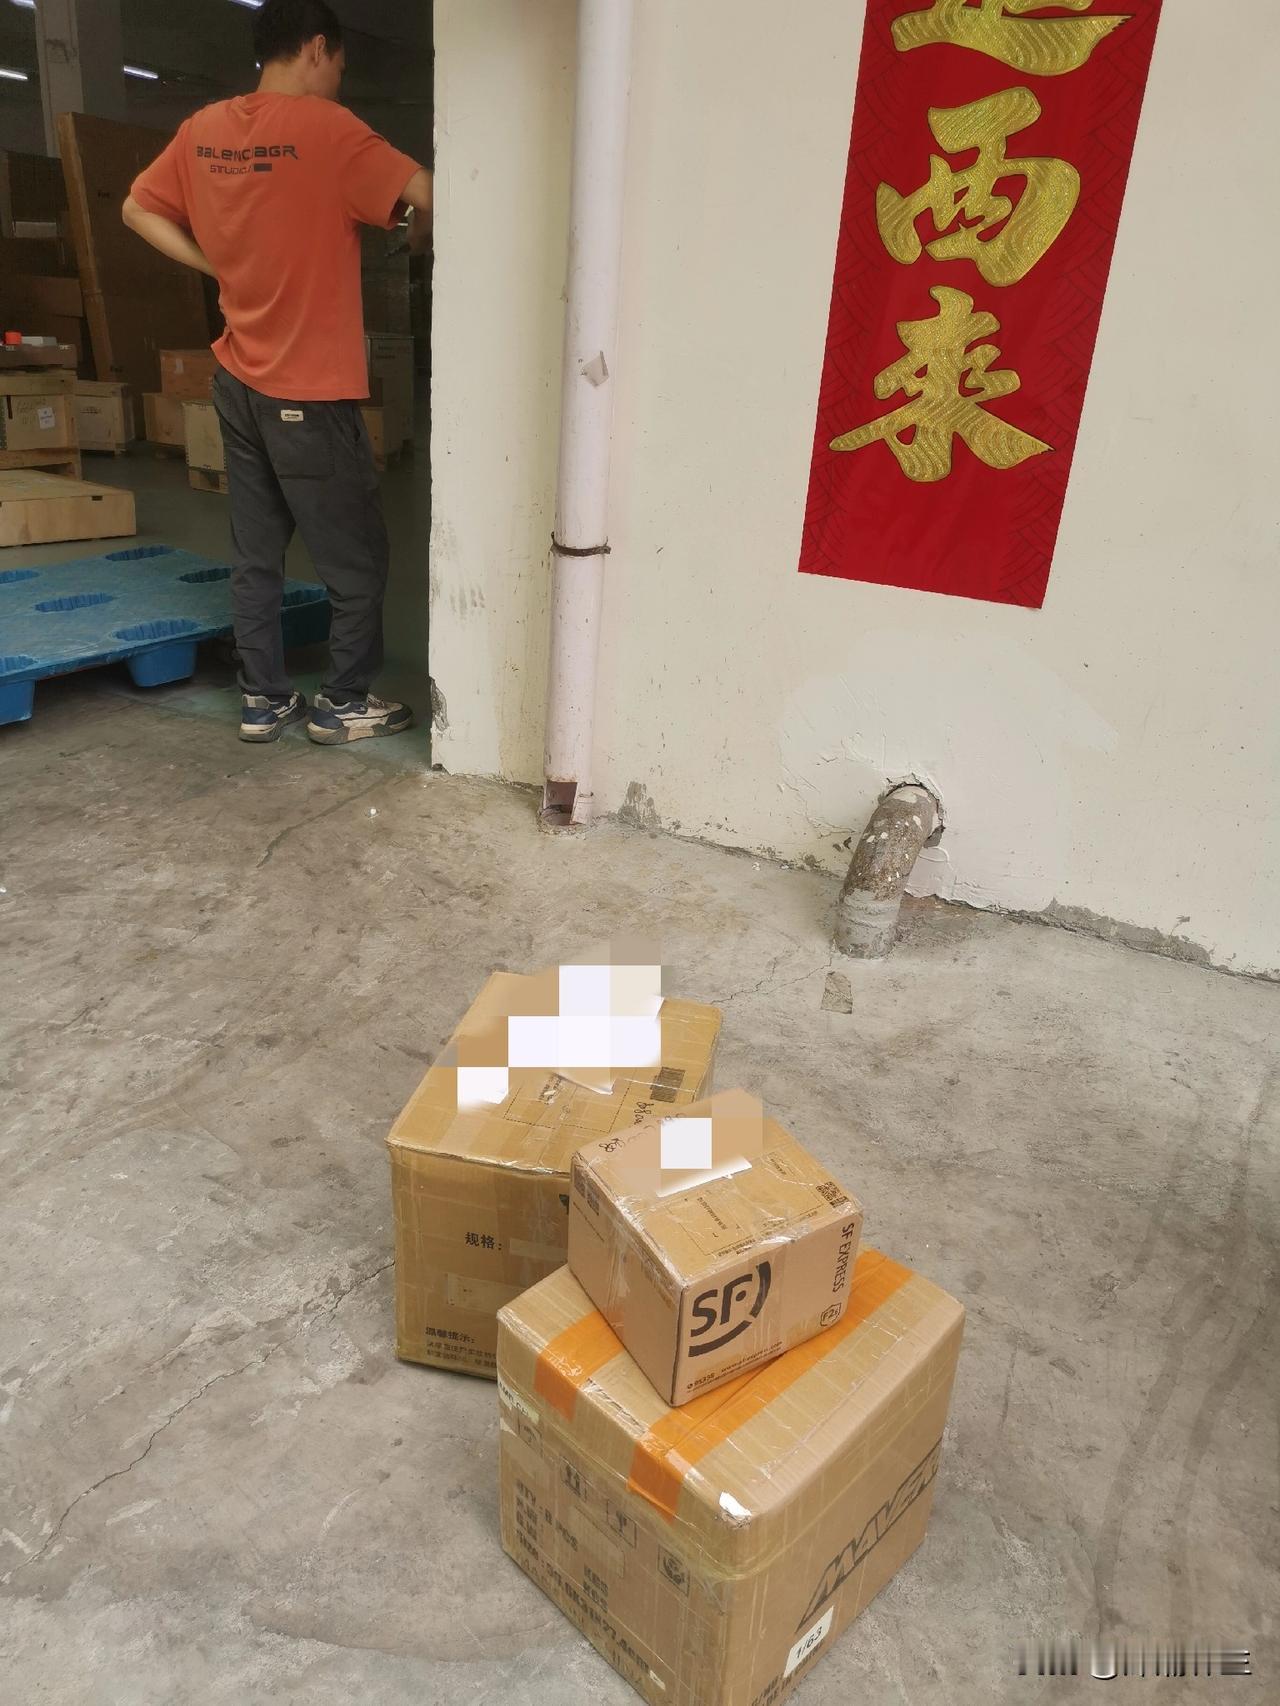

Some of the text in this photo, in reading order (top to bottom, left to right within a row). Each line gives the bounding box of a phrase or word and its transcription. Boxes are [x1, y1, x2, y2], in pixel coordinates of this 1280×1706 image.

[832, 1222, 855, 1293] SF EXPRESS
[796, 1626, 823, 1659] 1/63
